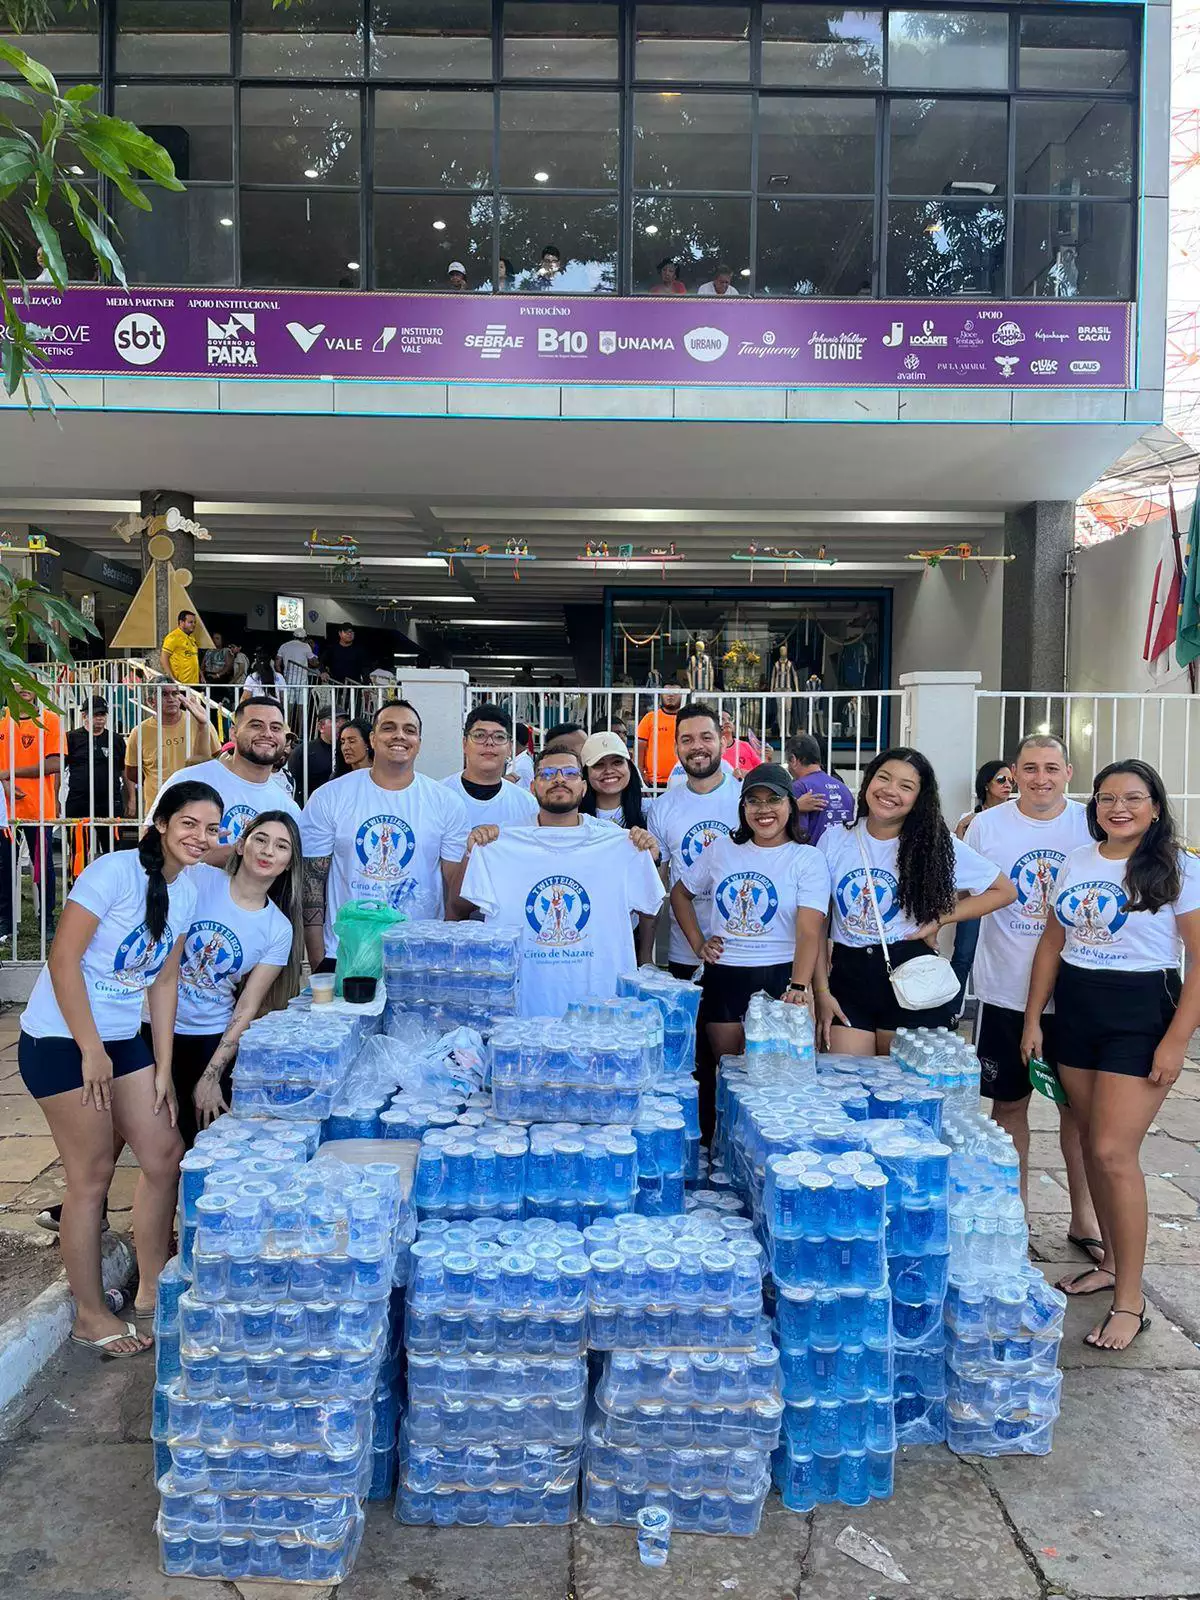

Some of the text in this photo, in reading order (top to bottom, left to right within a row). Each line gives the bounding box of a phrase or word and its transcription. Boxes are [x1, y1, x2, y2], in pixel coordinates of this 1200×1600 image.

[12, 296, 62, 306] RELIZAÇÃO
[106, 298, 175, 307] MEDIA PARTNER
[187, 300, 280, 310] APOIO INSTITUCIONAL
[519, 306, 571, 316] PATROCÍNIO
[976, 311, 1003, 319] APOIO
[118, 321, 162, 350] sbt
[401, 327, 444, 336] INSTITUTO
[1077, 326, 1111, 334] BRASIL
[324, 338, 363, 350] VALE
[401, 337, 443, 345] CULTURAL
[464, 335, 525, 348] SEBRAE
[538, 328, 588, 353] B10
[617, 337, 675, 350] UNAMA
[690, 338, 722, 350] URBANO
[839, 332, 867, 344] Walker
[1078, 334, 1111, 342] CACAU
[814, 344, 863, 360] BLONDE
[532, 876, 584, 896] TWITTEIROS
[1066, 881, 1124, 897] TWITTEIROS
[193, 922, 243, 958] TWITTEIROS
[548, 948, 560, 958] de
